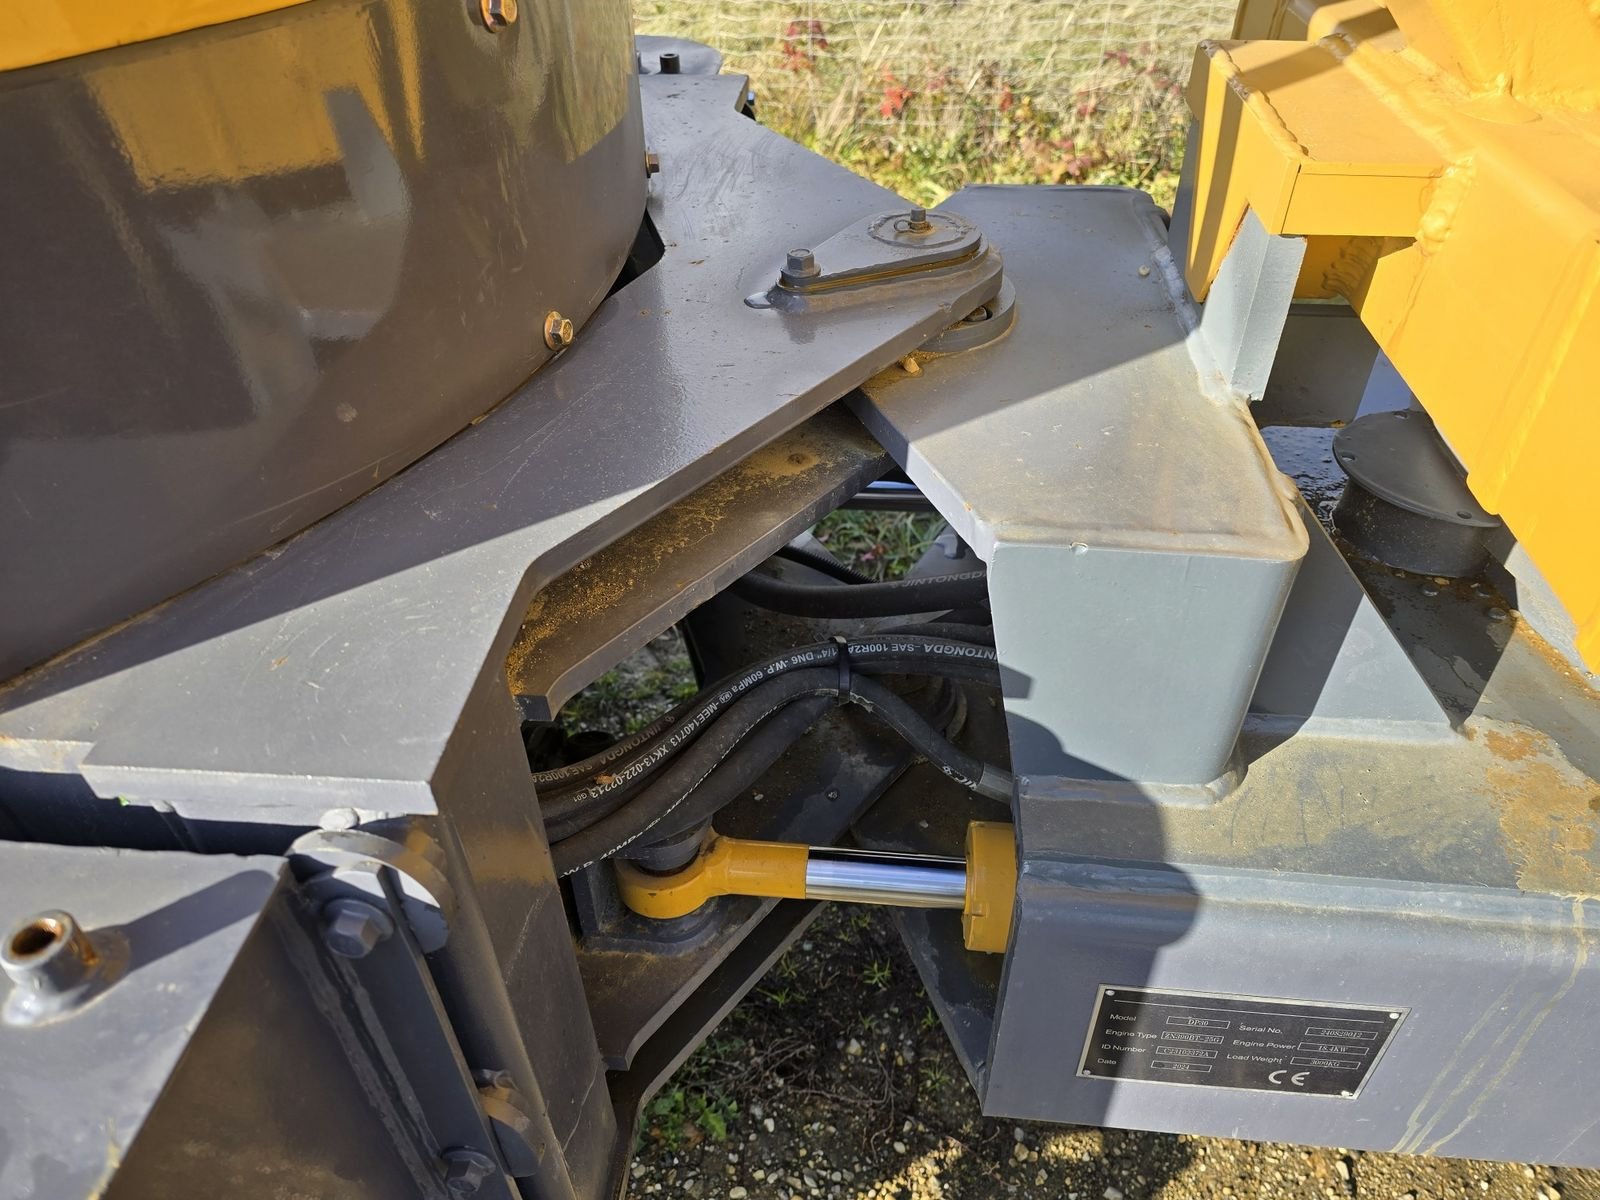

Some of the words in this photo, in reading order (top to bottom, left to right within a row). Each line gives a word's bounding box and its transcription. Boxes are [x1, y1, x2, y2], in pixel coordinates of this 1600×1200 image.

[902, 570, 987, 587] JINTONGD
[791, 651, 814, 664] DN6
[924, 643, 998, 661] INTONGDA
[731, 669, 763, 693] 60MPa
[600, 721, 662, 765] JINTONGDA
[1105, 1029, 1135, 1037] Engine
[1137, 1031, 1158, 1040] Type
[1239, 1024, 1265, 1032] Serial
[1267, 1026, 1283, 1034] No.
[1112, 1044, 1146, 1053] Number
[1232, 1039, 1264, 1048] Engine
[1266, 1041, 1297, 1049] Power
[1226, 1053, 1249, 1061] Load
[1251, 1055, 1283, 1064] Weight
[1268, 1070, 1310, 1086] CE
